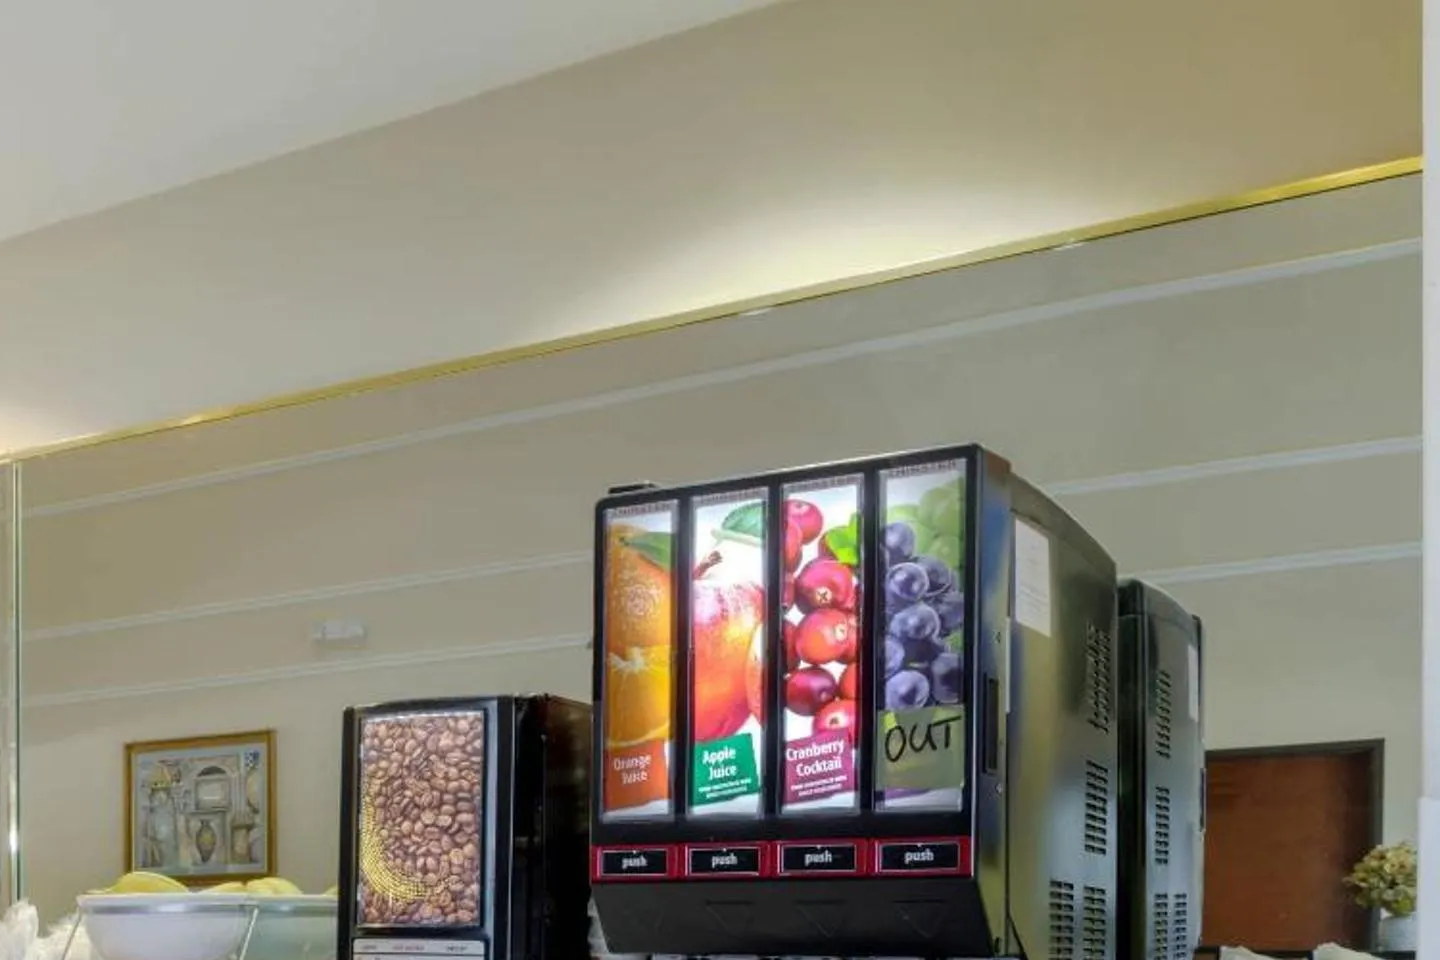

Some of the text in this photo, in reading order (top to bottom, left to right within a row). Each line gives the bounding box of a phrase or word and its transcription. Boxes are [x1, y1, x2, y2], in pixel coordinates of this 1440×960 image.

[885, 715, 962, 763] OUT
[702, 747, 736, 764] Apple
[785, 739, 844, 762] Cranberry
[613, 754, 652, 771] Orange
[796, 756, 842, 777] Cocktail
[708, 764, 737, 780] Juice
[622, 855, 648, 870] push
[711, 852, 738, 869] push
[804, 850, 833, 867] push
[904, 848, 935, 865] push
